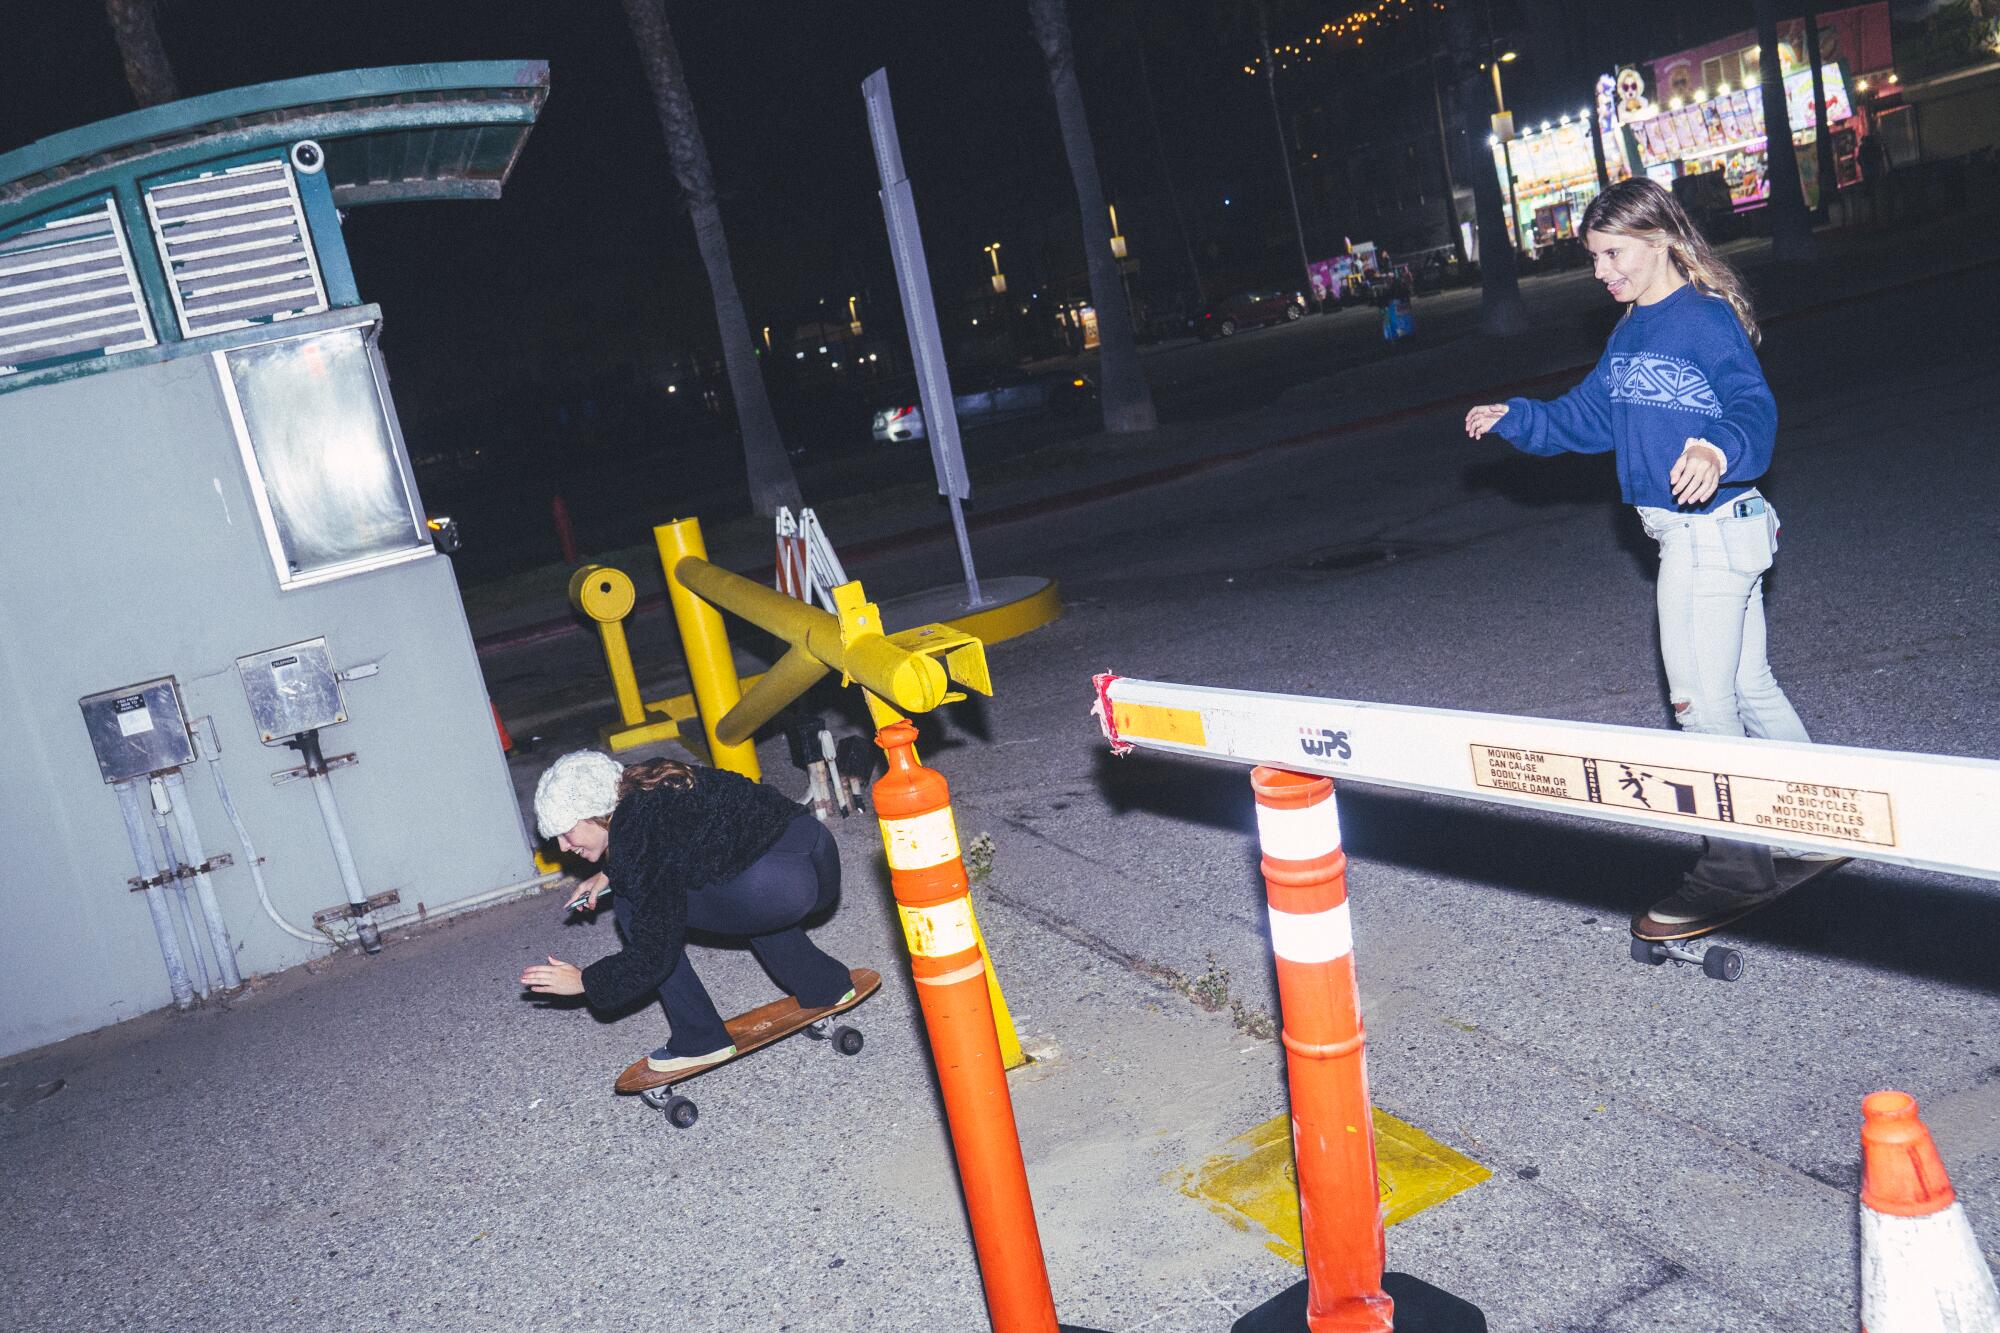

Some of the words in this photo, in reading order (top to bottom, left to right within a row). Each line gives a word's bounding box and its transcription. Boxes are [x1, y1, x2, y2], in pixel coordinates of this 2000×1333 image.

[1487, 749, 1522, 761] MOVING
[1524, 752, 1545, 763] ARM
[1488, 758, 1507, 769] CAN
[1508, 761, 1537, 773] CAUSE
[1491, 769, 1521, 780] BODILY
[1524, 773, 1551, 784] HARM
[1553, 777, 1567, 786] OR
[1492, 778, 1528, 792] VEHICLE
[1786, 783, 1818, 797] CARS
[1777, 794, 1793, 804] NO
[1756, 814, 1772, 825] OR
[1772, 805, 1865, 827] MOTORCYCLES
